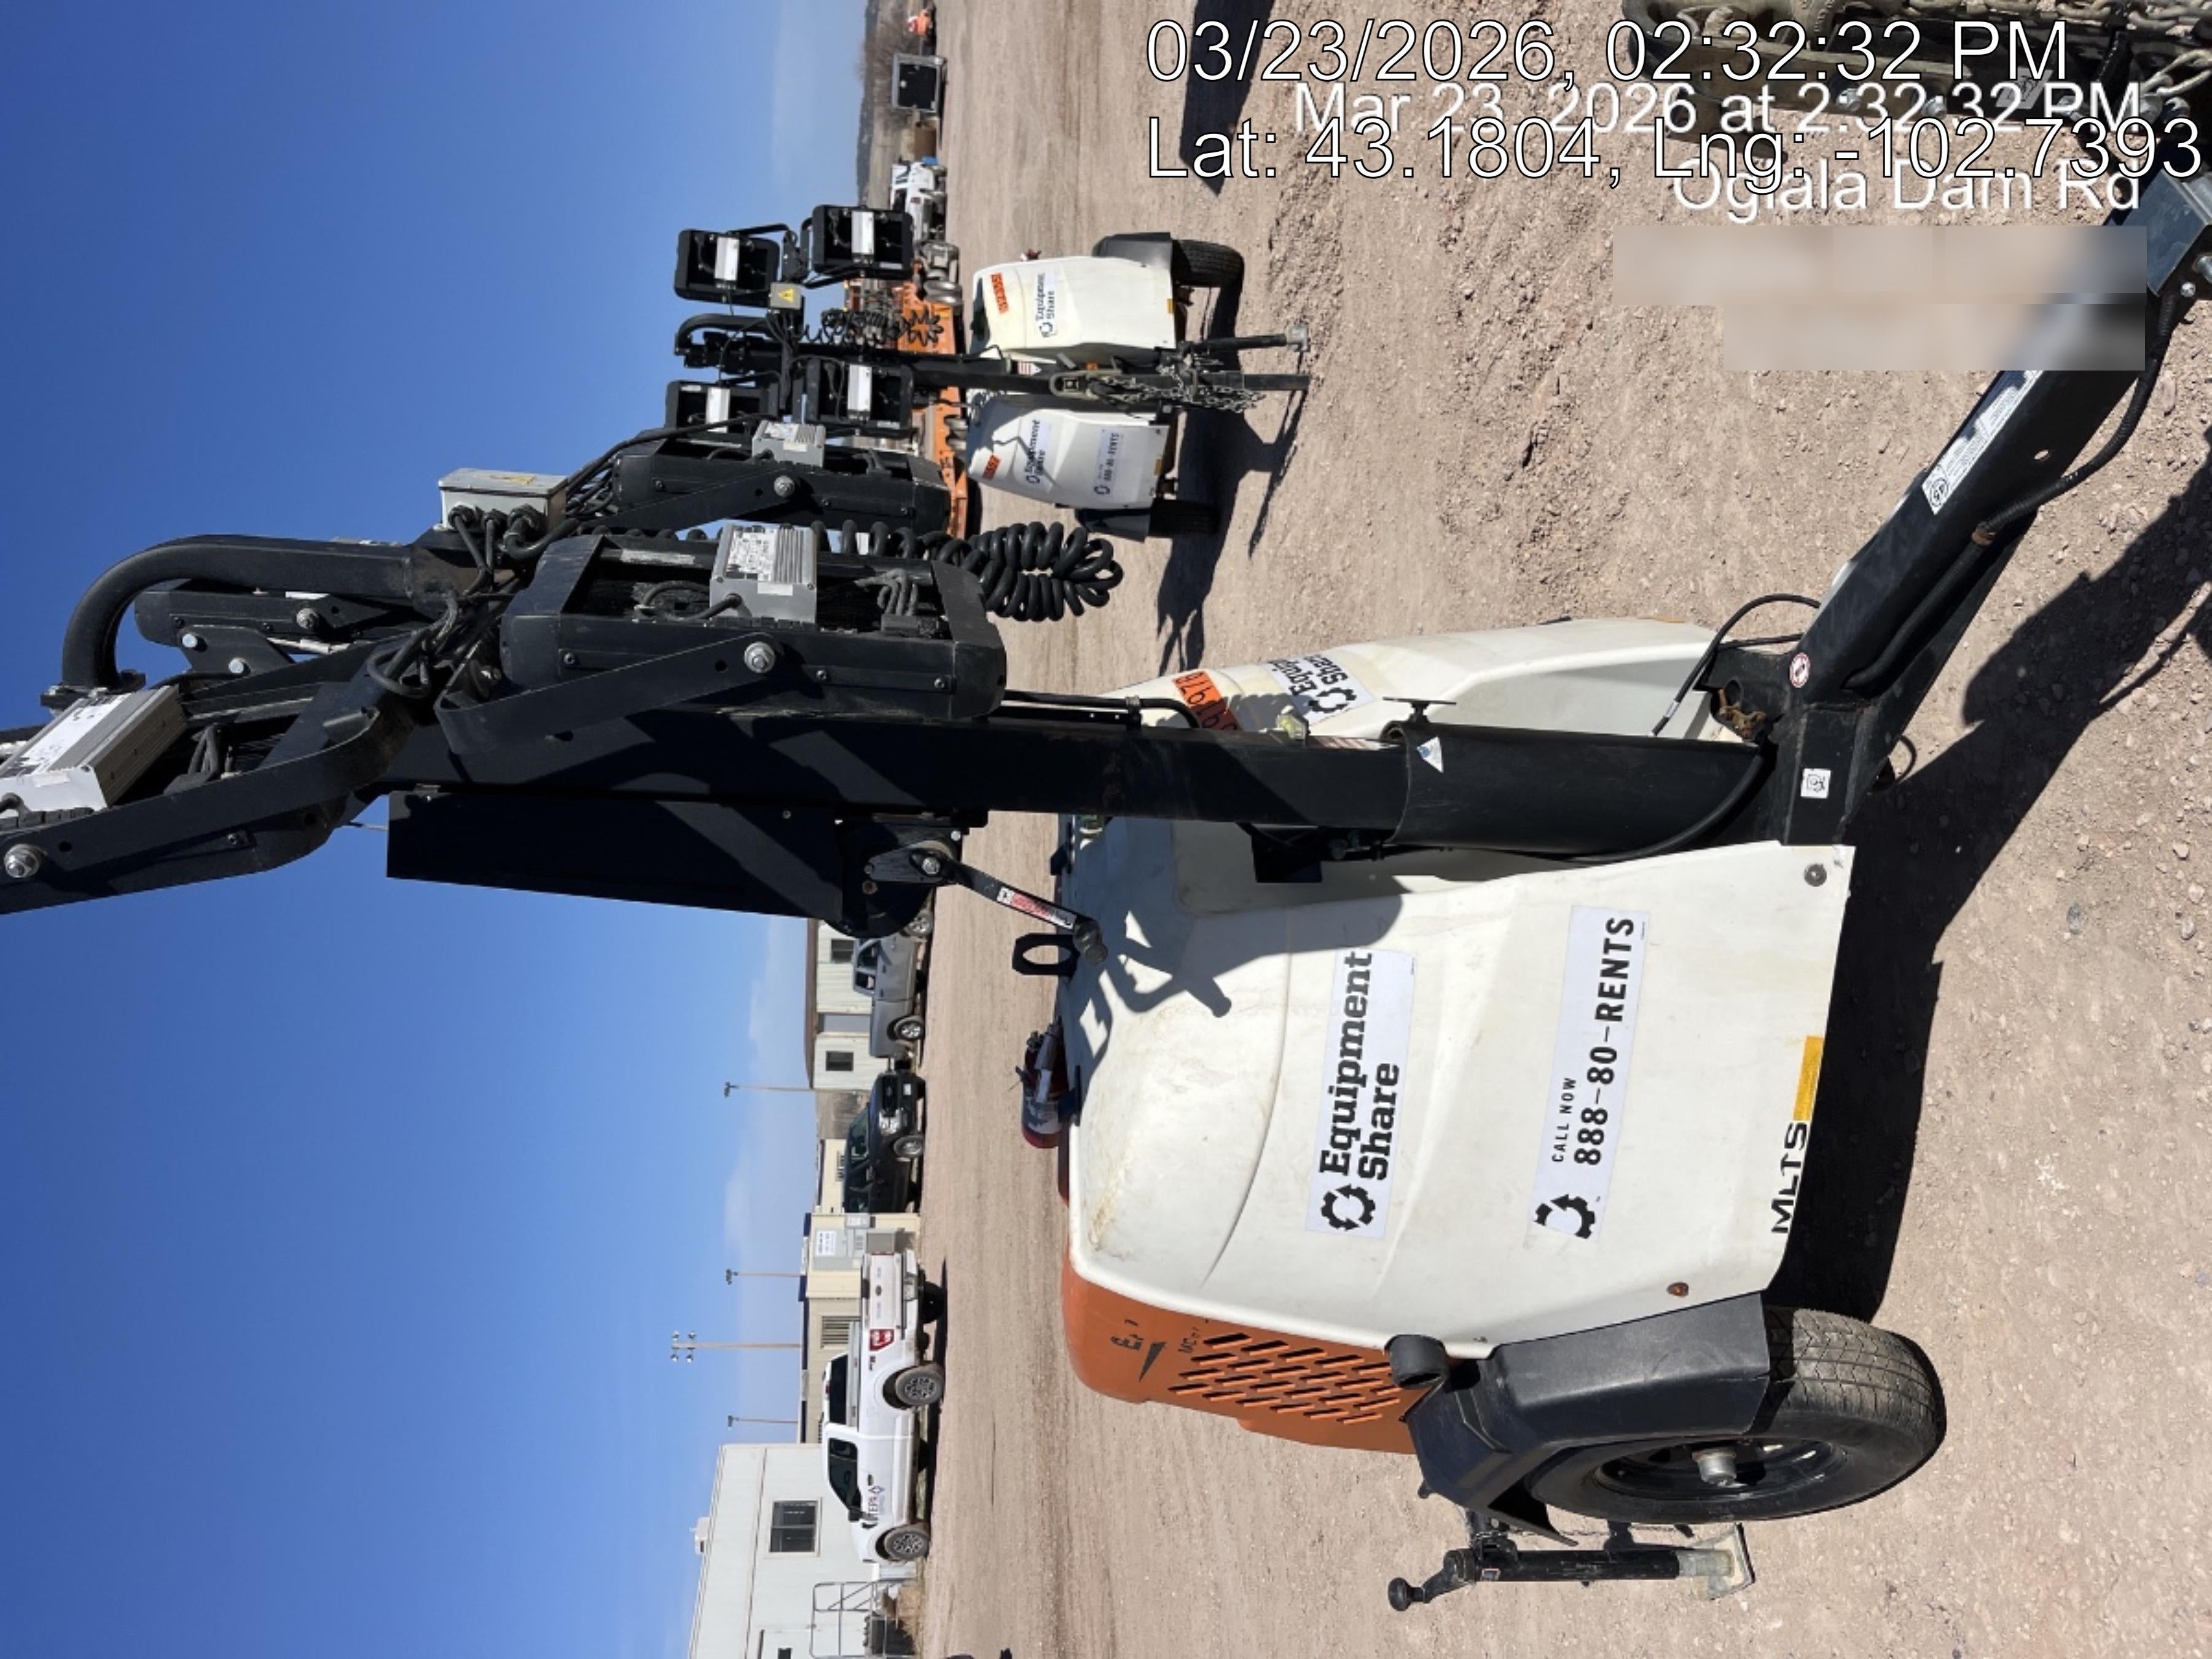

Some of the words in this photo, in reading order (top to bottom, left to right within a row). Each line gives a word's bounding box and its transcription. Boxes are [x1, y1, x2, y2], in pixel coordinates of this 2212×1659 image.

[1318, 952, 1373, 1177] Equipment
[1559, 1077, 1577, 1115] NOW
[1573, 917, 1634, 1166] 888-80-RENTS
[1357, 1062, 1400, 1181] Share
[1551, 1123, 1570, 1163] CALL
[1770, 1122, 1808, 1234] MLTS
